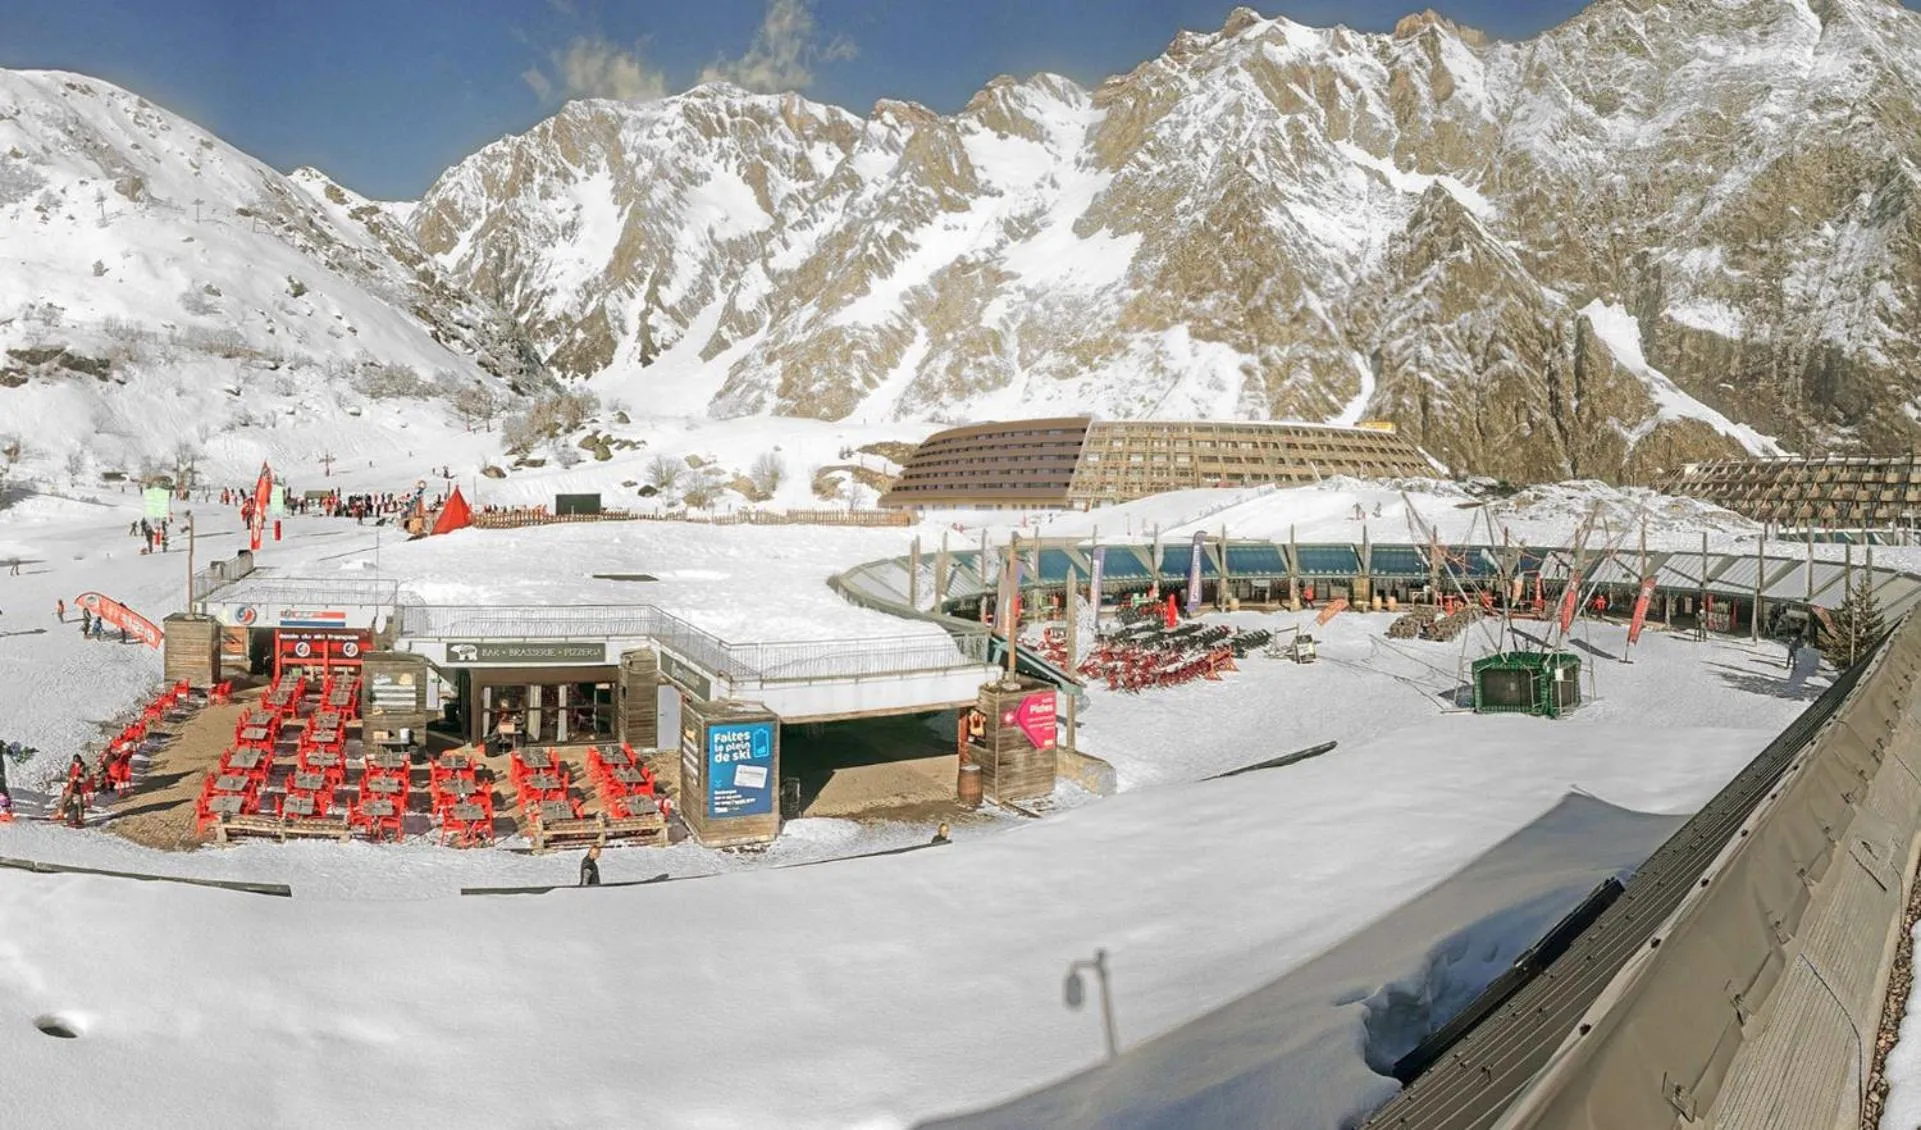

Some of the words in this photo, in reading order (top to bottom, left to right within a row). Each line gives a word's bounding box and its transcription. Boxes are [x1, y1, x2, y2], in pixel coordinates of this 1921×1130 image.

[481, 648, 500, 657] BAR
[509, 648, 557, 657] BRASSERIE
[564, 648, 600, 657] PIZZERIA
[714, 731, 751, 743] Faites
[714, 743, 724, 752] le
[725, 741, 751, 752] plein
[714, 752, 730, 763] de
[732, 749, 751, 761] ski
